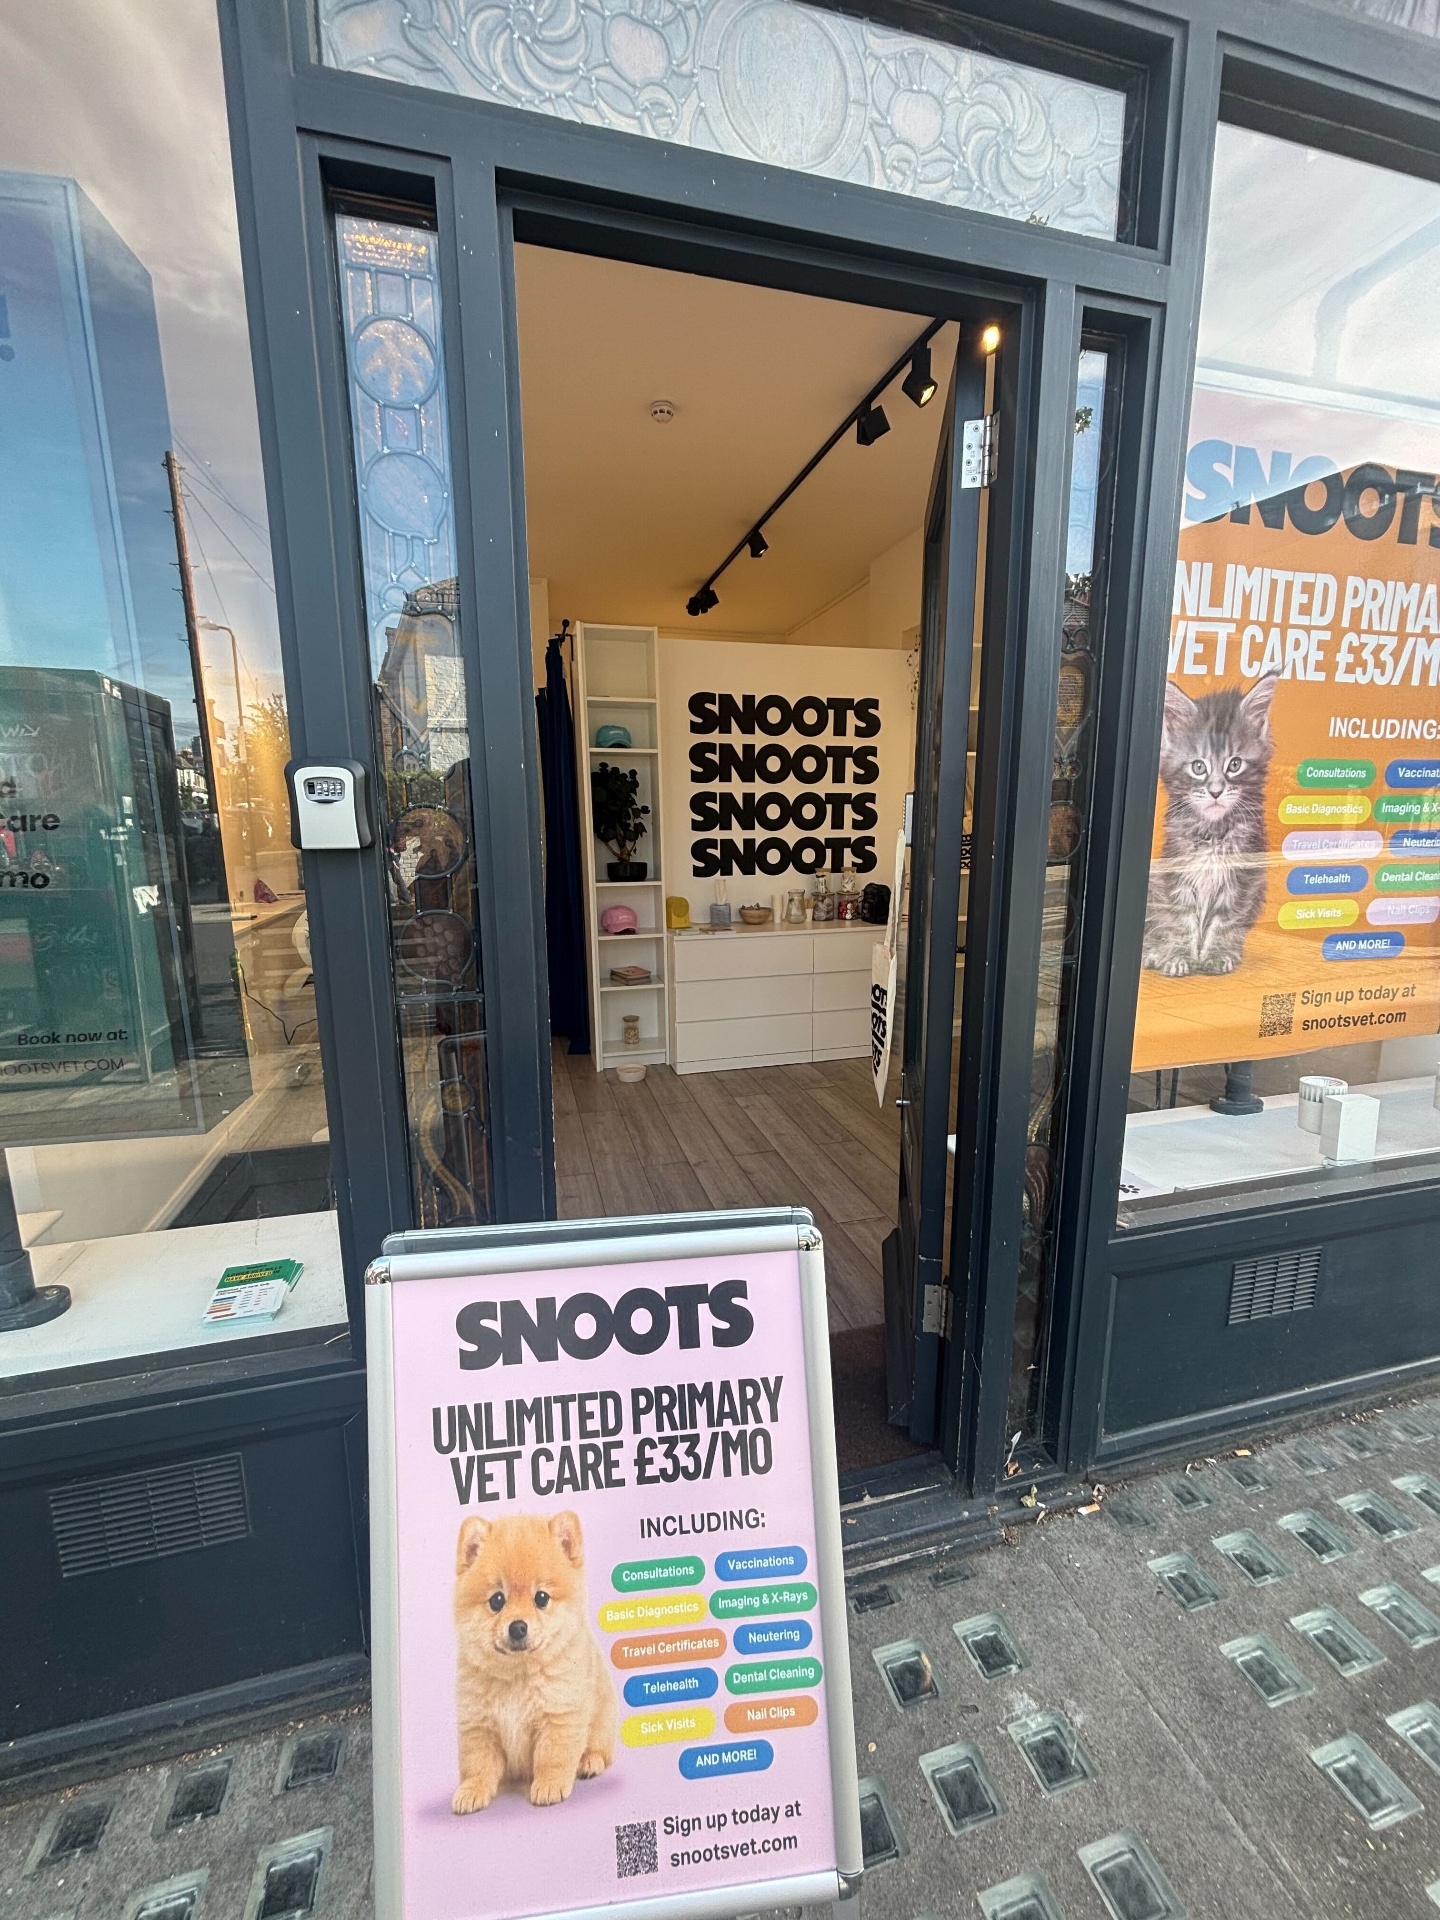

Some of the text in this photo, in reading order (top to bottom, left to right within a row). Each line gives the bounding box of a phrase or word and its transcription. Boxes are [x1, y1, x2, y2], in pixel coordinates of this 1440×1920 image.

[1184, 439, 1440, 550] SNOOT
[1341, 575, 1440, 634] PRIMA
[1166, 620, 1440, 687] VET CARE £33/M
[688, 691, 882, 739] SNOOTS
[688, 741, 880, 785] SNOOTS
[1306, 766, 1367, 779] Consultations
[689, 791, 879, 832] SNOOTS
[1285, 803, 1364, 816] Basic Diagnostics
[1381, 802, 1421, 816] Imaging
[1422, 802, 1430, 813] &
[1292, 839, 1376, 851] Travel Certificates
[690, 835, 878, 878] SNOOTS
[1304, 873, 1351, 885] Telehealth
[1381, 871, 1413, 883] Dental
[1296, 907, 1342, 920] Sick Visits
[1386, 904, 1431, 917] Nail Clips
[1335, 938, 1391, 951] AND MORE!
[1300, 983, 1417, 1008] Sign up today at
[1301, 1010, 1407, 1032] snootsvet.com
[17, 1030, 61, 1046] Book
[65, 1031, 103, 1043] now
[0, 1057, 125, 1077] OOTSVET.COM
[455, 1280, 754, 1370] SNOOTS
[432, 1375, 784, 1455] UNLIMITED PRIMARY
[450, 1427, 773, 1505] VET CARE £33/MO
[639, 1508, 766, 1538] INCLUDING:
[727, 1554, 795, 1571] Vaccinations
[622, 1565, 695, 1582] Consultations
[718, 1590, 809, 1610] Imaging & X-Rays
[606, 1602, 700, 1622] Basic Diagnostics
[748, 1629, 800, 1644] Neutering
[621, 1638, 720, 1658] Travel Certificates
[733, 1666, 815, 1684] Dental Cleaning
[643, 1677, 699, 1695] Telehealth
[747, 1706, 796, 1721] Nail Clips
[640, 1717, 697, 1735] Sick Visits
[696, 1748, 757, 1768] AND MORE!
[663, 1800, 802, 1837] Sign up today at
[670, 1835, 798, 1867] snootsvet.com
